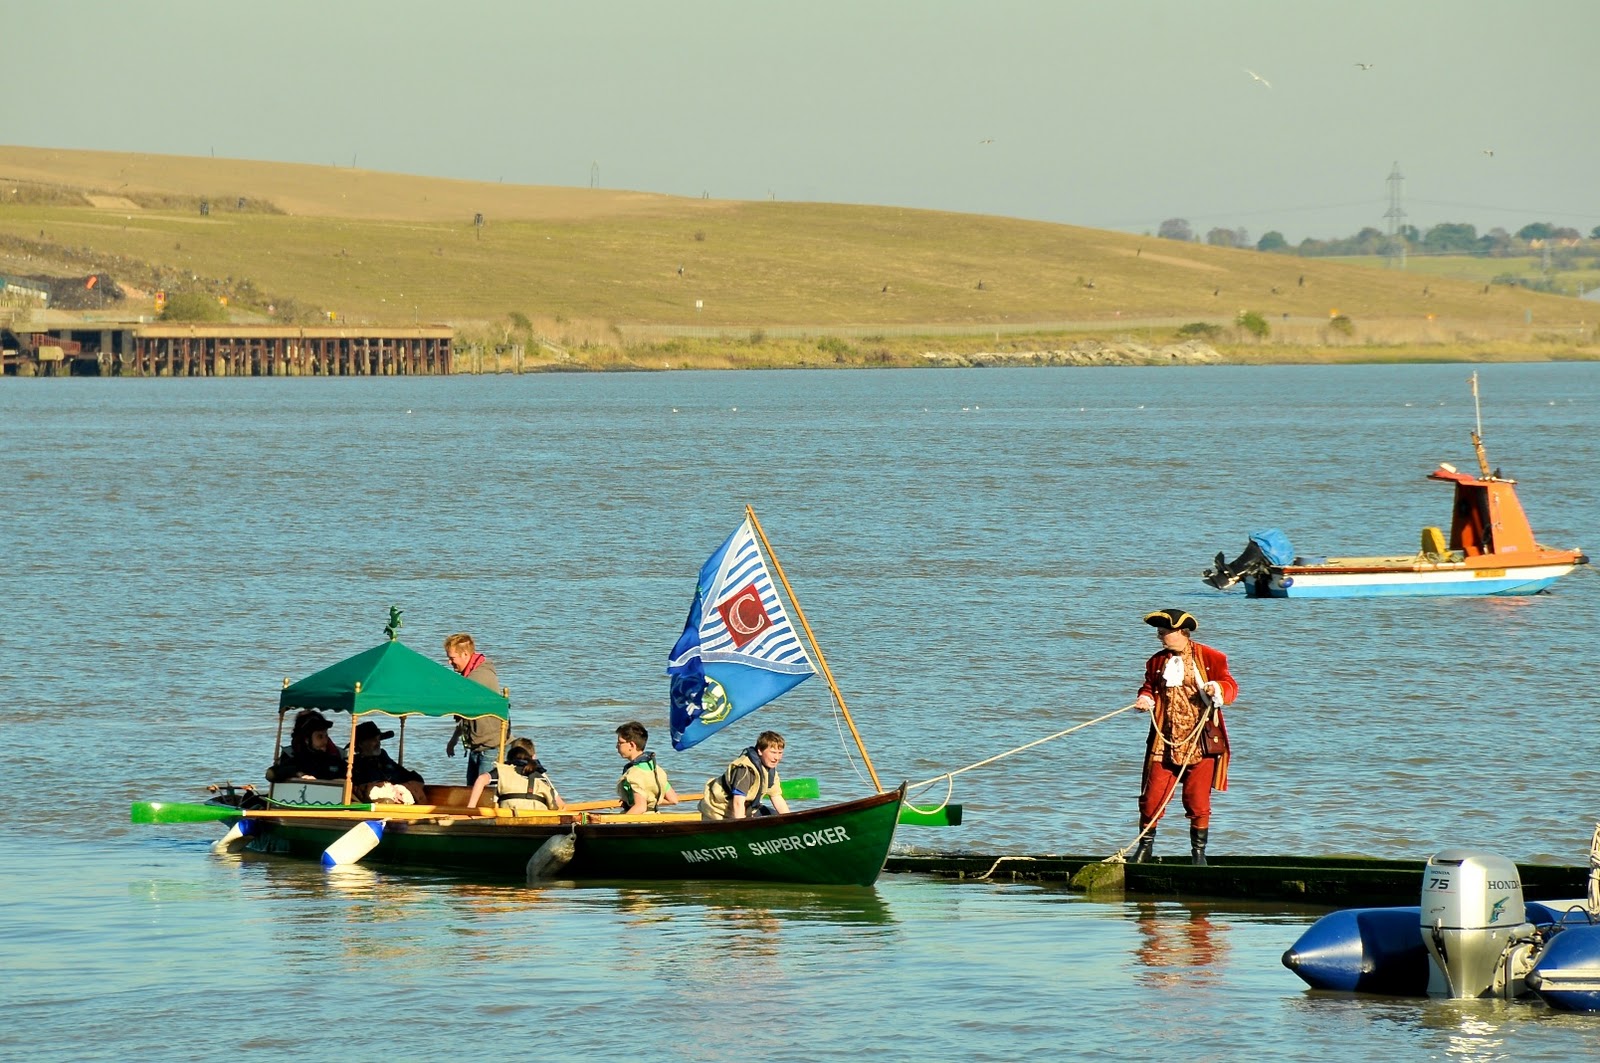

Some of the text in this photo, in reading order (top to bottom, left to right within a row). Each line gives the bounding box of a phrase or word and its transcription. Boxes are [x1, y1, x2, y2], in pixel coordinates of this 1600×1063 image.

[729, 593, 765, 635] C
[748, 826, 851, 856] SHIPBROKER
[1430, 878, 1449, 889] 75
